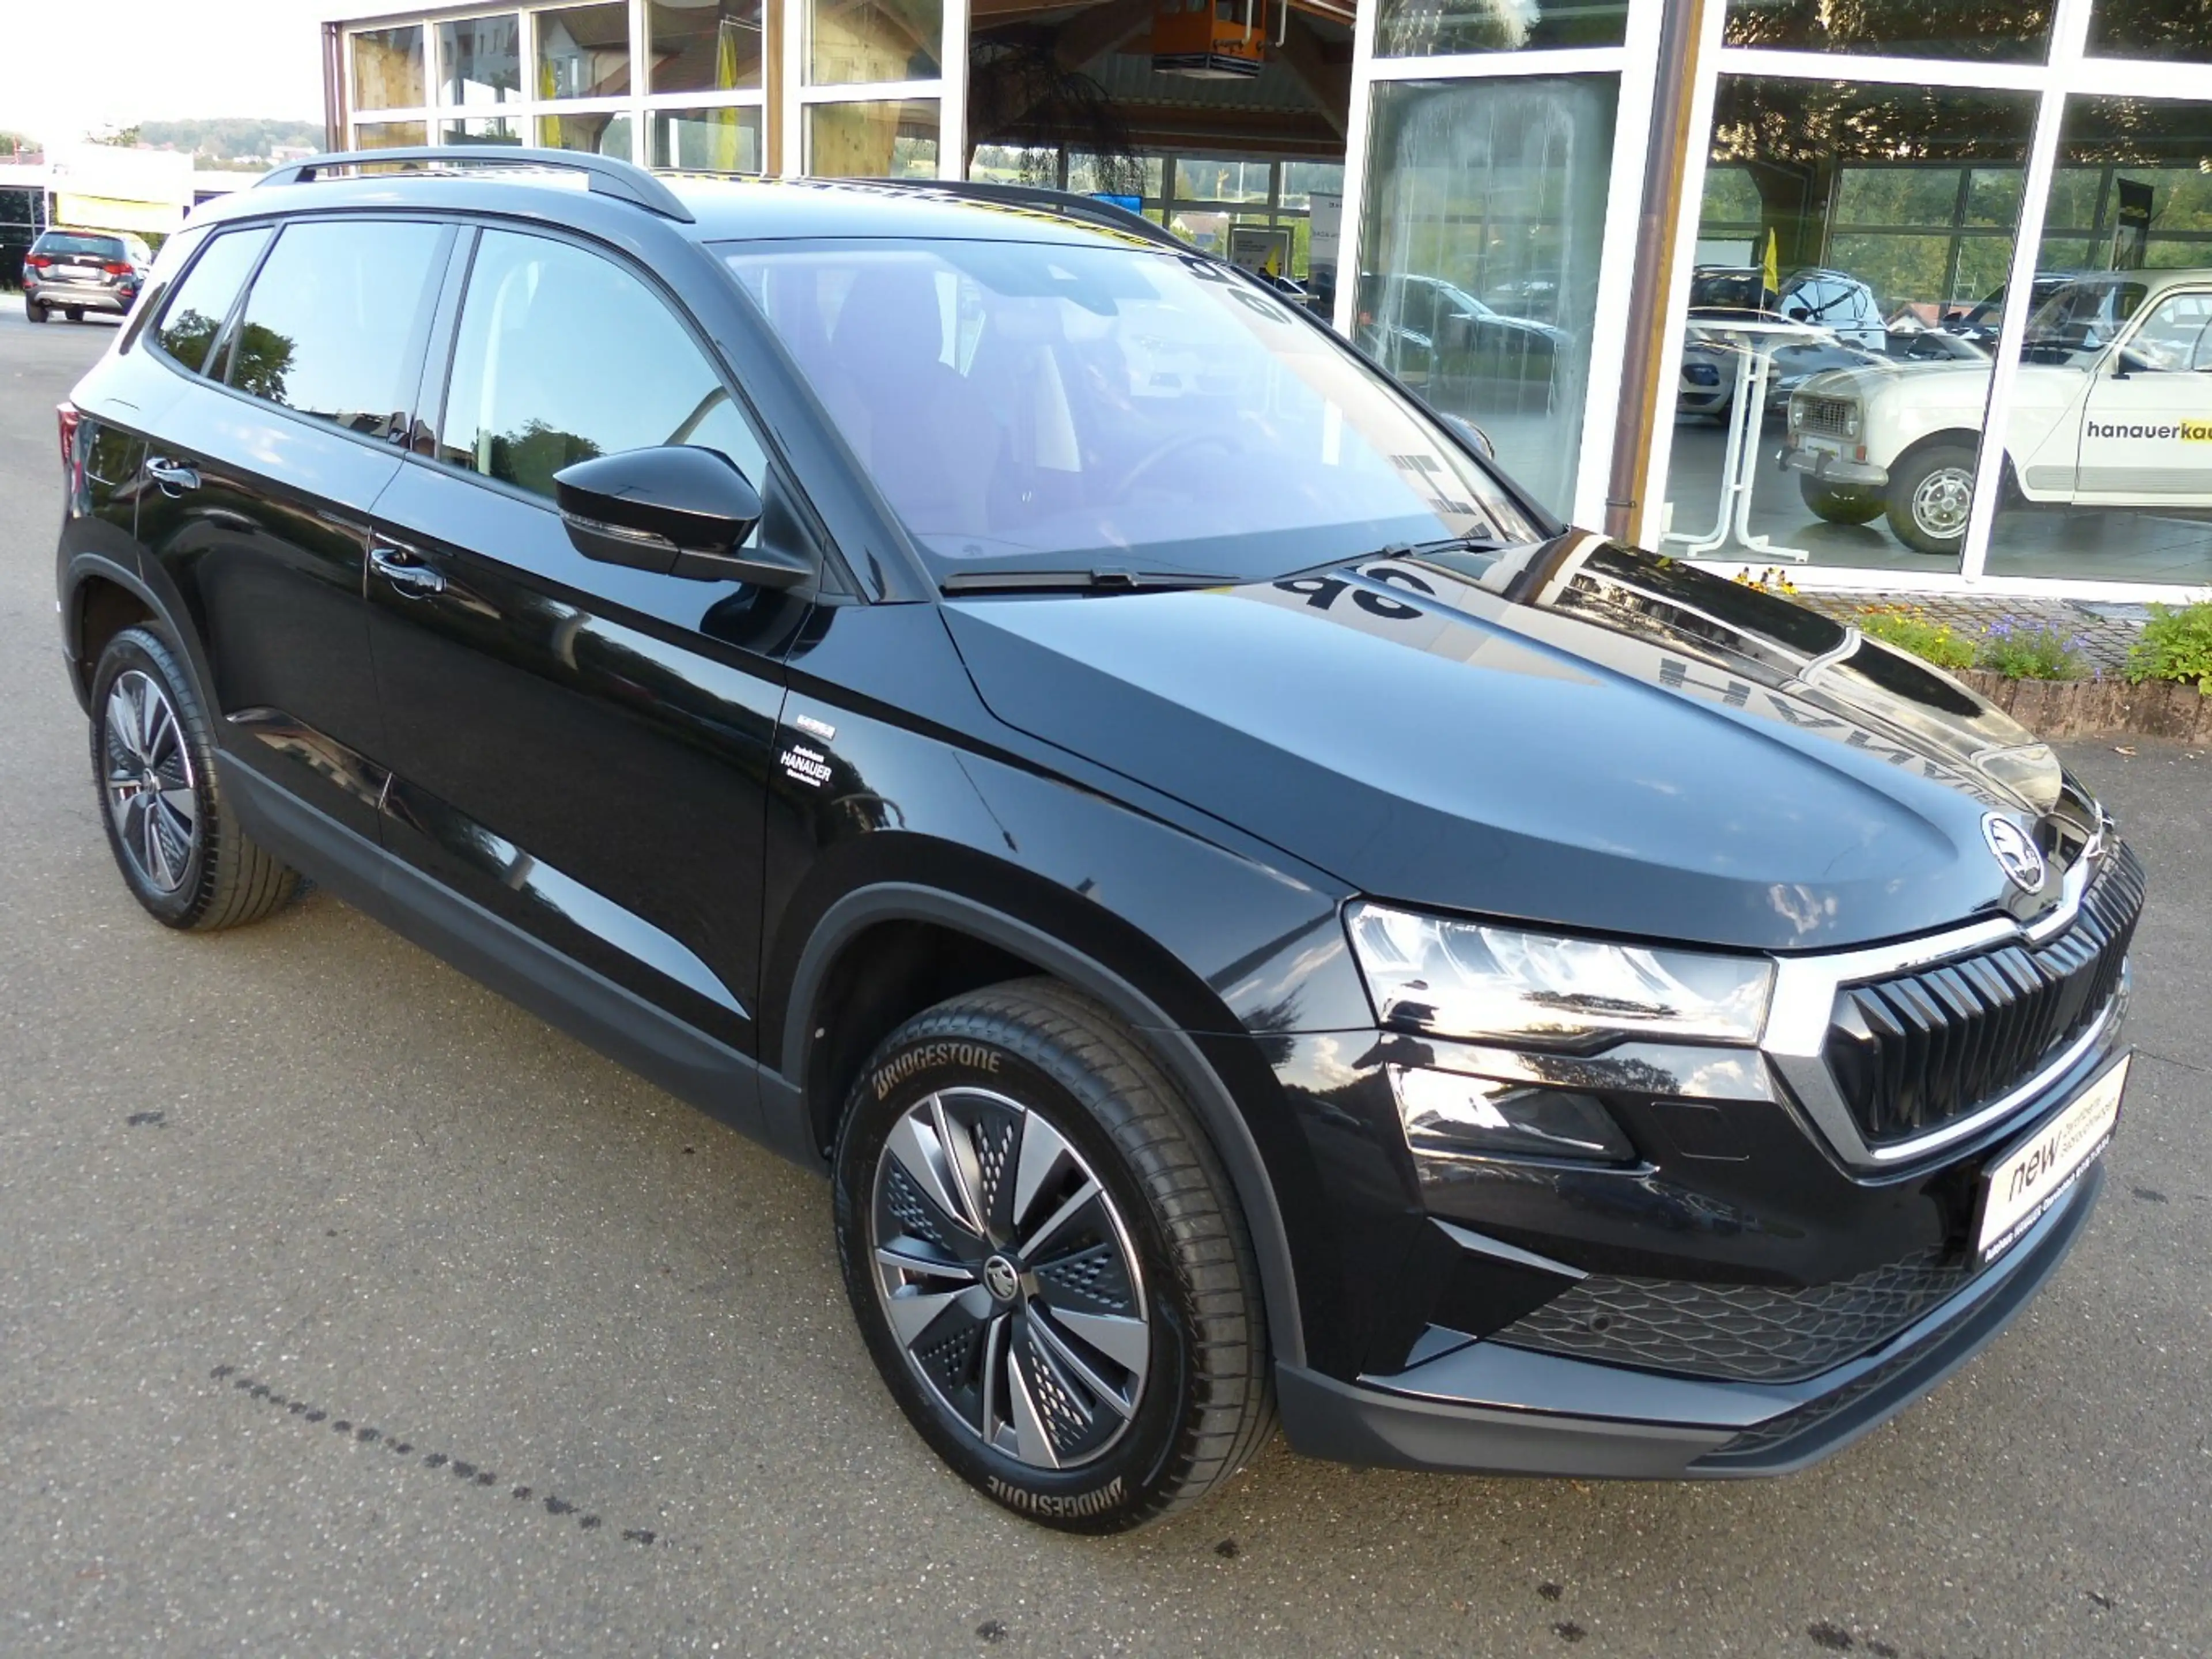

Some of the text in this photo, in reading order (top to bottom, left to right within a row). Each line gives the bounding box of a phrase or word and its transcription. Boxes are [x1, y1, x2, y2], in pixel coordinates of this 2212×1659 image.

[780, 749, 832, 782] HANAUER
[872, 1043, 1001, 1100] BRIDGESTONE
[2008, 1130, 2062, 1202] new
[985, 1475, 1126, 1517] BRIDGESTONE
